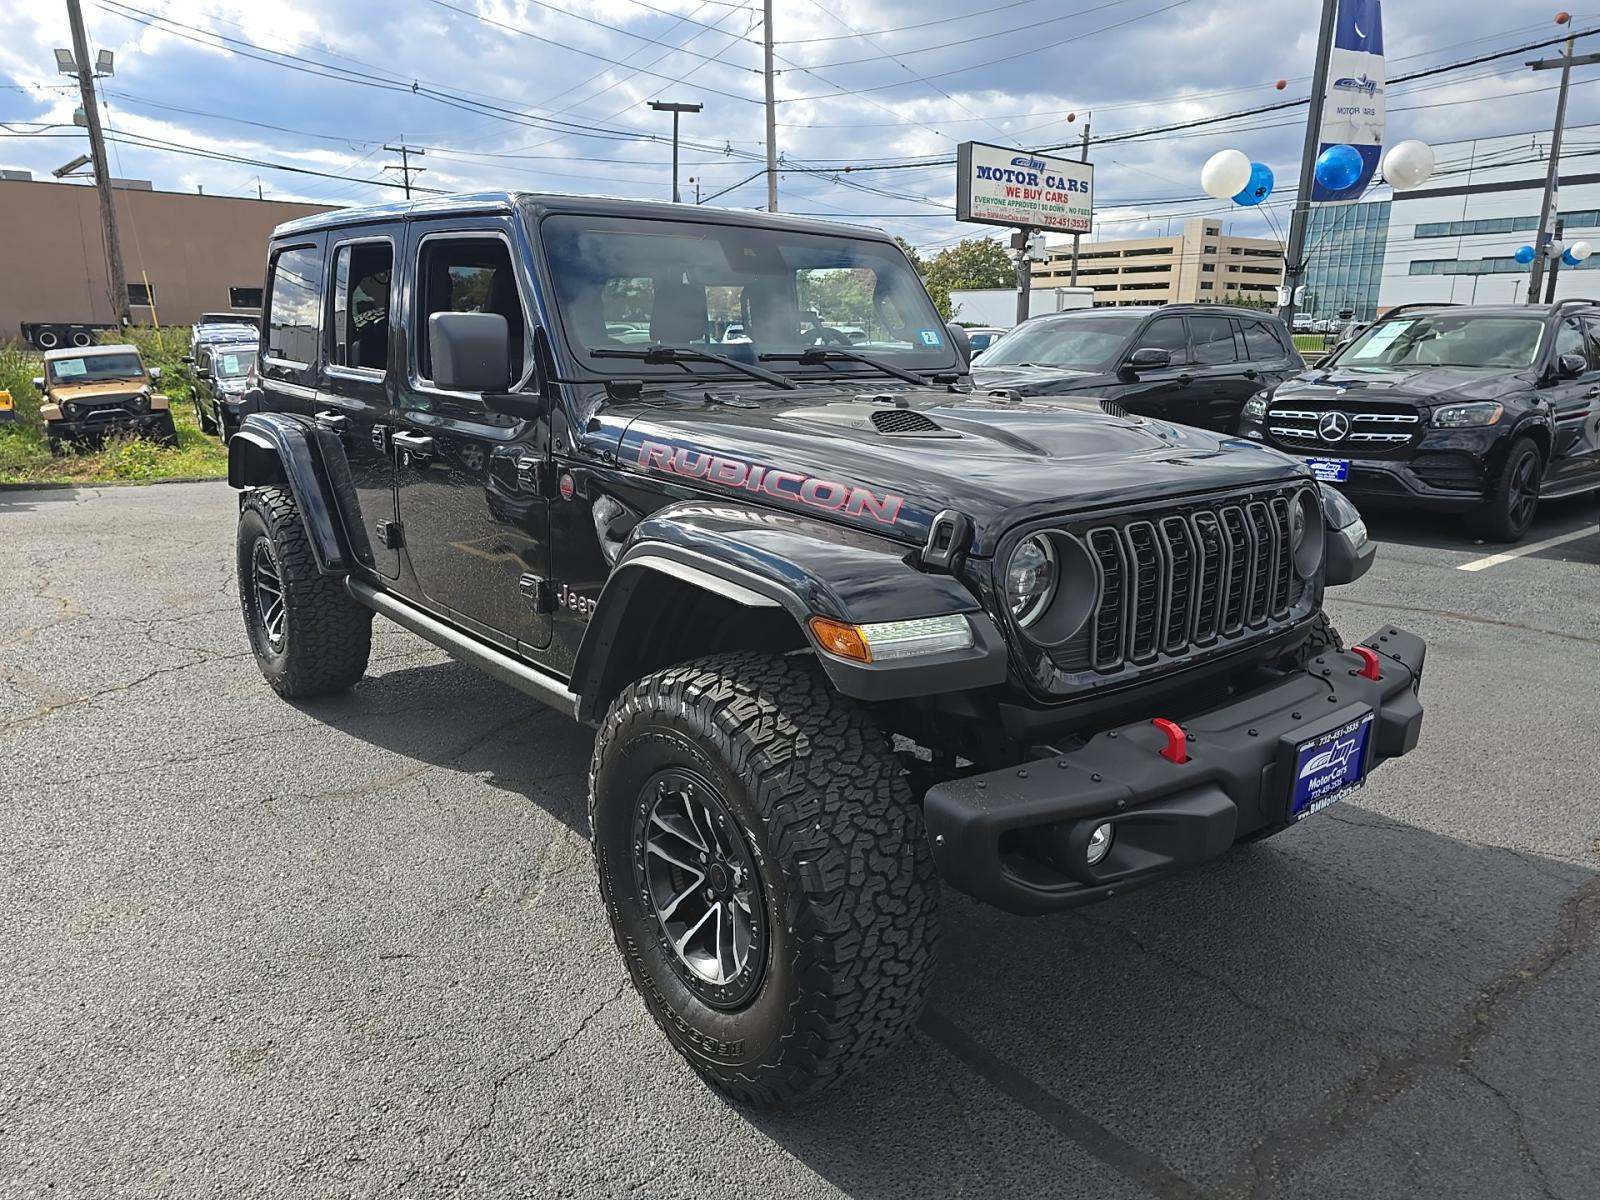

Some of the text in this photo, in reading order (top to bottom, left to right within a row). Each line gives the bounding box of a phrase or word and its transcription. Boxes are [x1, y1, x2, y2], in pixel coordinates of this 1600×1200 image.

[1337, 106, 1360, 115] MOTOR
[976, 165, 1088, 193] MOTOR CARS
[974, 195, 1007, 207] EVERYONE
[1007, 199, 1037, 210] APPROVED
[1068, 207, 1077, 215] NO
[1077, 208, 1091, 216] FEES
[1006, 186, 1069, 204] WE BUY CARS
[1043, 215, 1089, 229] 732-451-3535
[637, 440, 905, 525] RUBICON
[557, 583, 597, 621] Jeep
[1308, 765, 1348, 792] MotorCars
